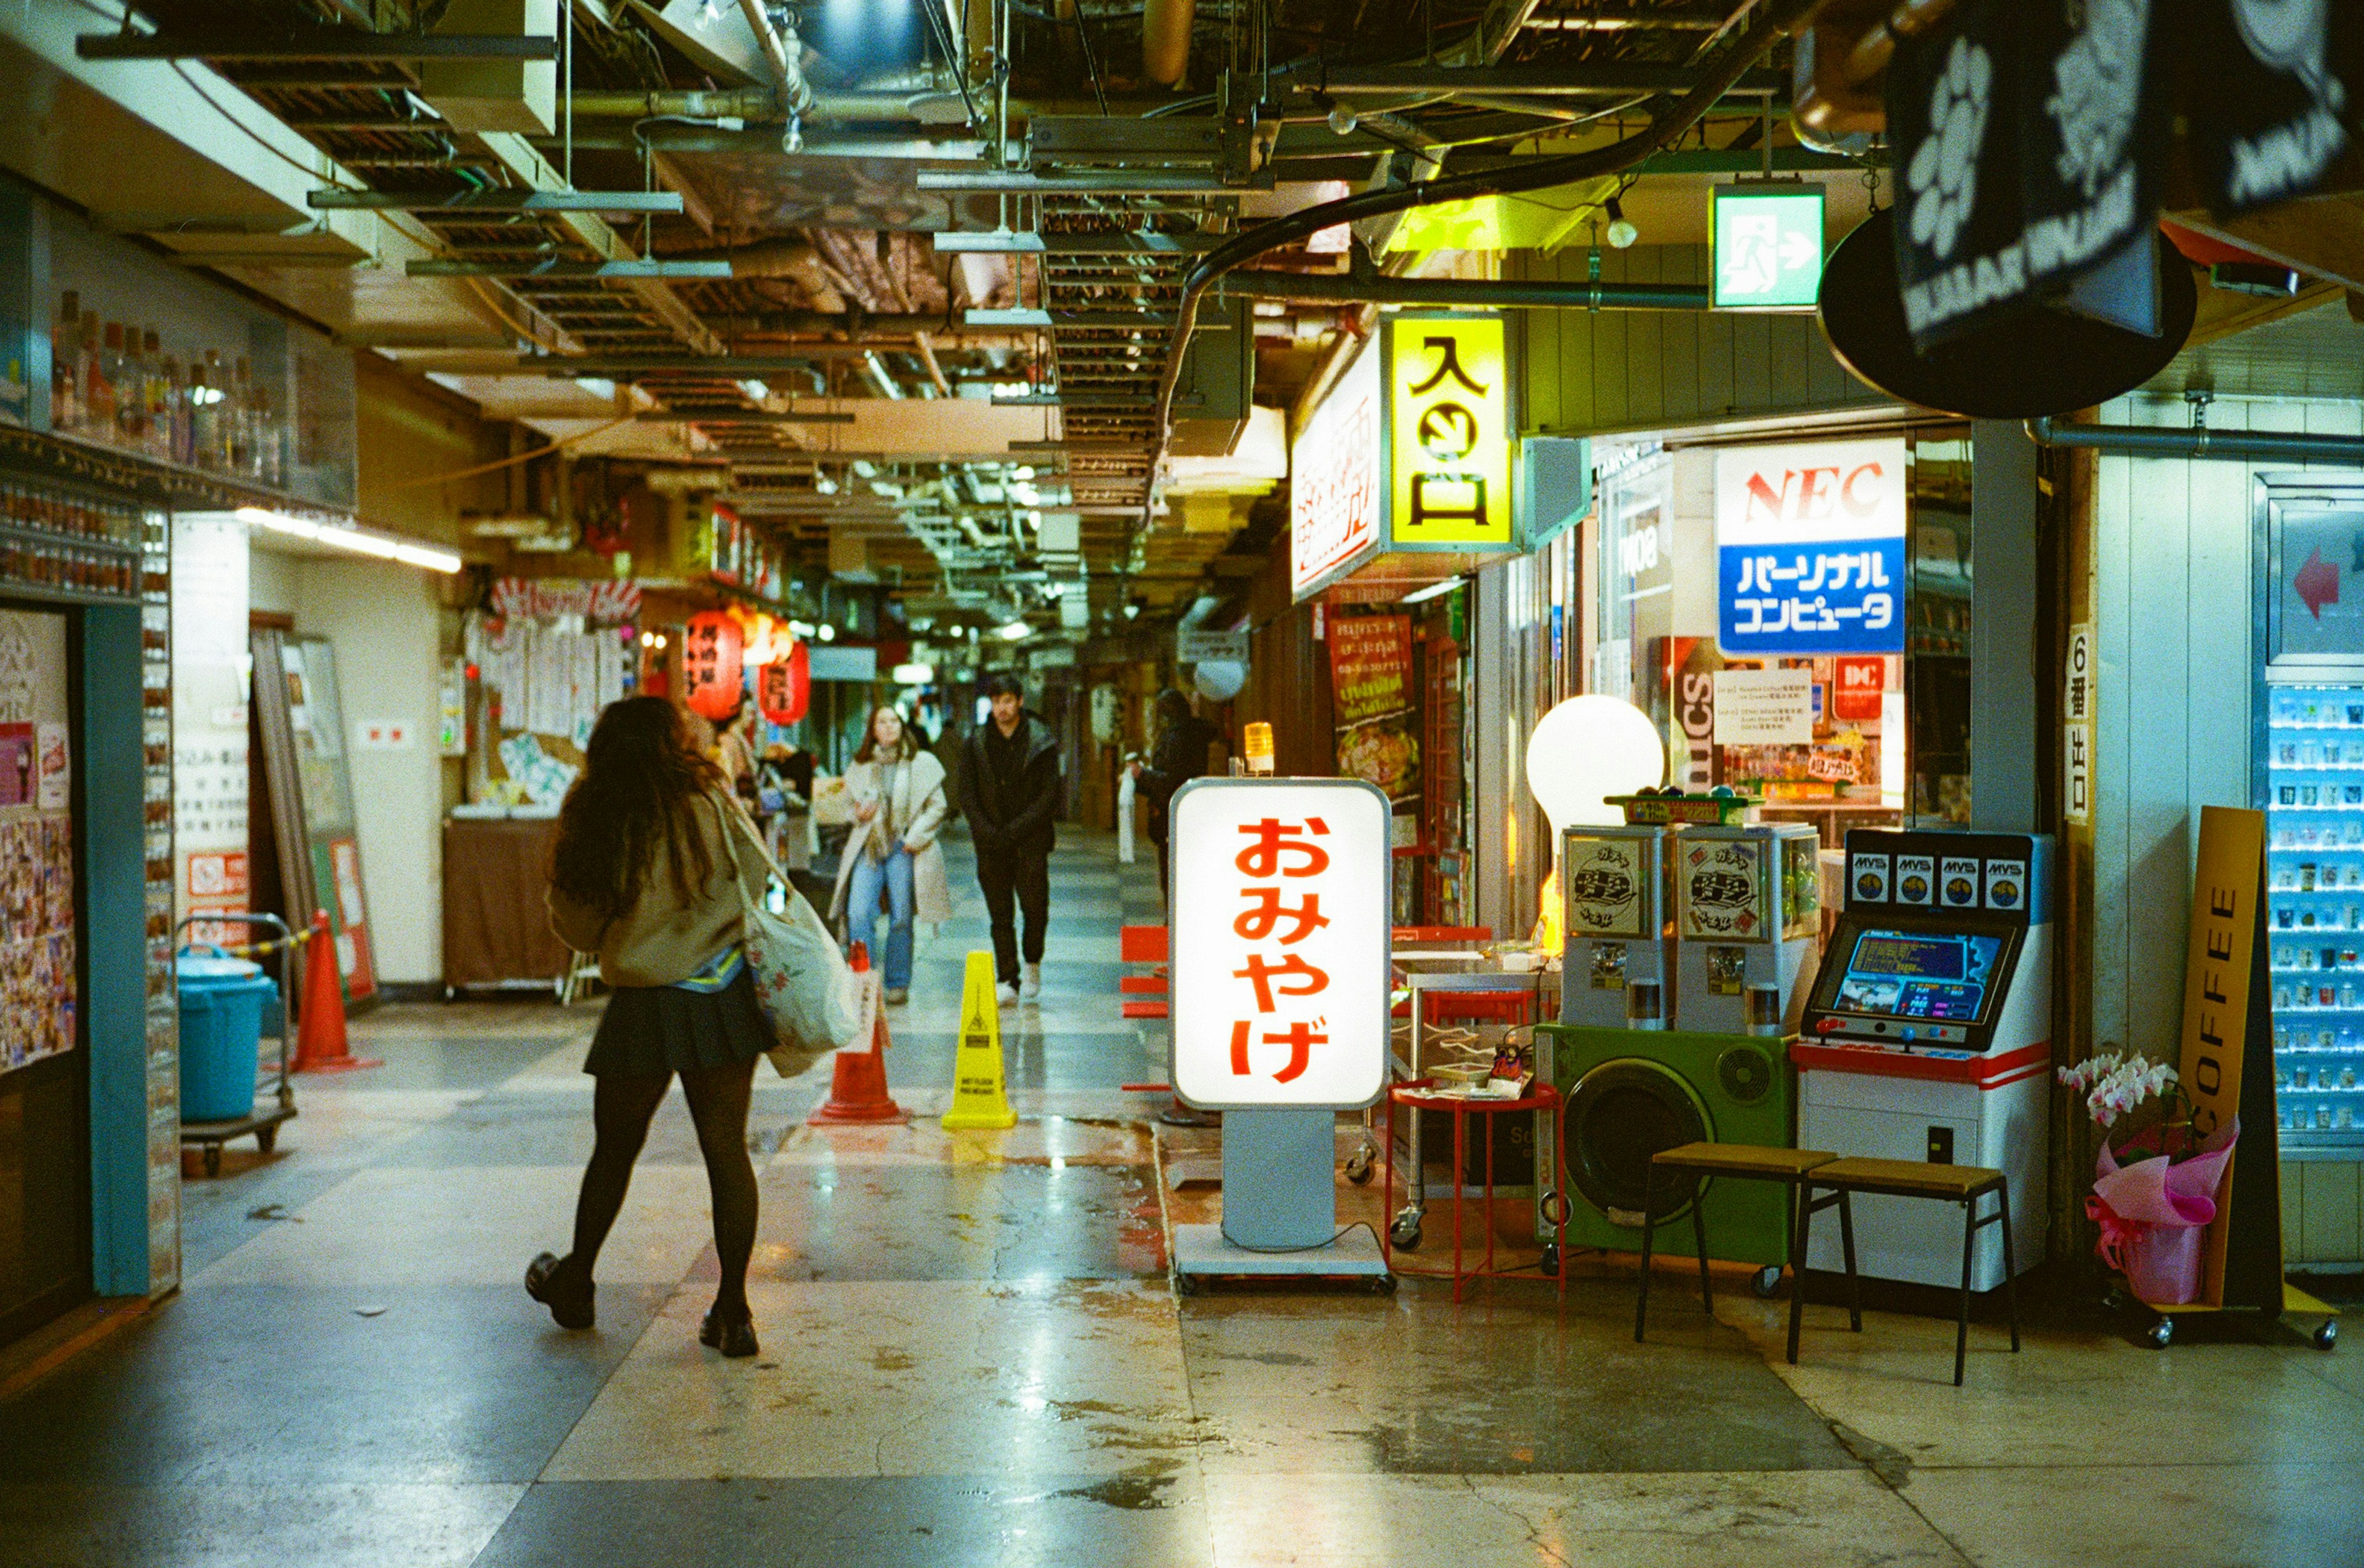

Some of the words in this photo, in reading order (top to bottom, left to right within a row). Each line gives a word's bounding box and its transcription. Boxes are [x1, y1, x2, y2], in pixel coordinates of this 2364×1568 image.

[1408, 336, 1490, 526] 入口
[1746, 462, 1884, 523] NEC
[1737, 552, 1889, 593] パーソナル
[1735, 592, 1892, 633] コンピュータ
[1598, 846, 1630, 869] ガチャ
[1716, 848, 1748, 870] ガチャ
[1854, 856, 1886, 869] MVS
[1899, 859, 1931, 872] MVS
[1944, 861, 1976, 873] MVS
[1988, 863, 2022, 875] MVS
[1230, 816, 1330, 1084] おみやげ
[2195, 887, 2236, 1142] COFFEE
